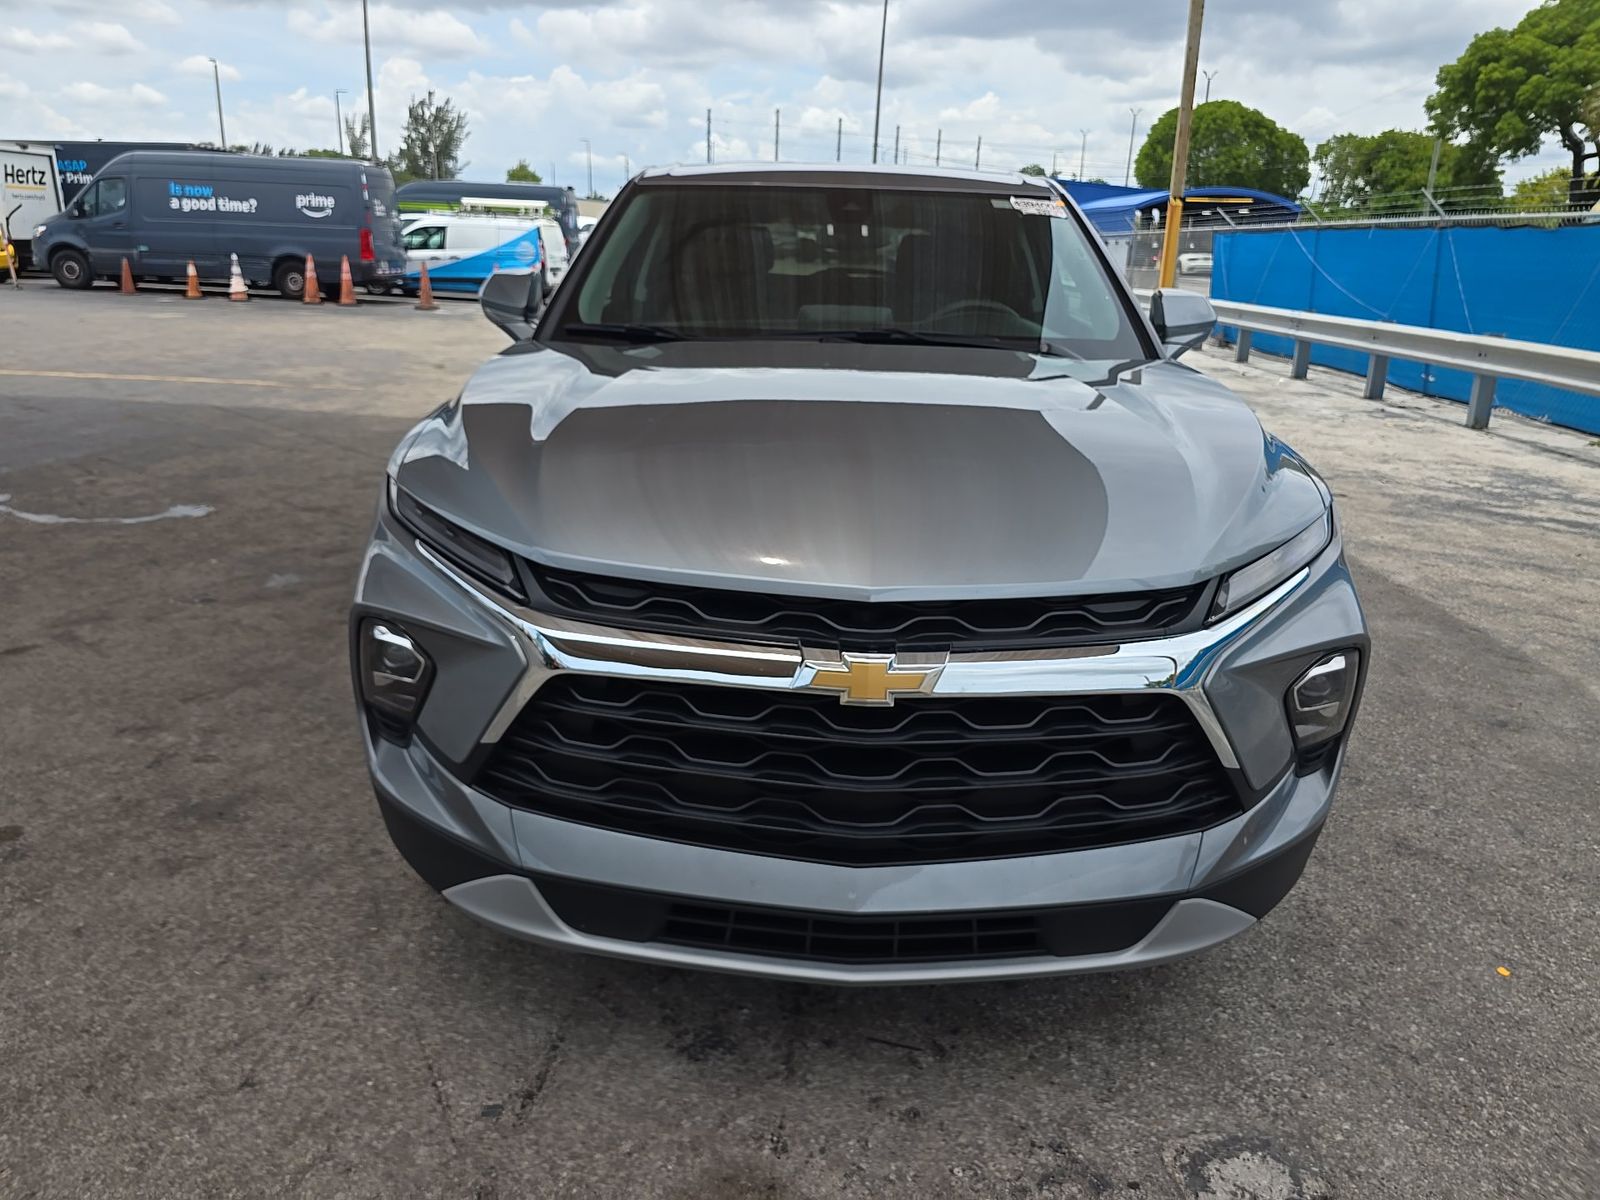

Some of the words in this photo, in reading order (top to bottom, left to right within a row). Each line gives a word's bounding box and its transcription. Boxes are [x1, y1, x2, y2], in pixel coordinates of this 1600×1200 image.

[4, 164, 46, 185] Hertz
[66, 172, 93, 184] Prim
[169, 181, 181, 196] Is
[183, 185, 213, 197] now
[169, 197, 180, 209] a
[181, 196, 216, 212] good
[217, 197, 258, 213] time?
[295, 192, 335, 209] prime
